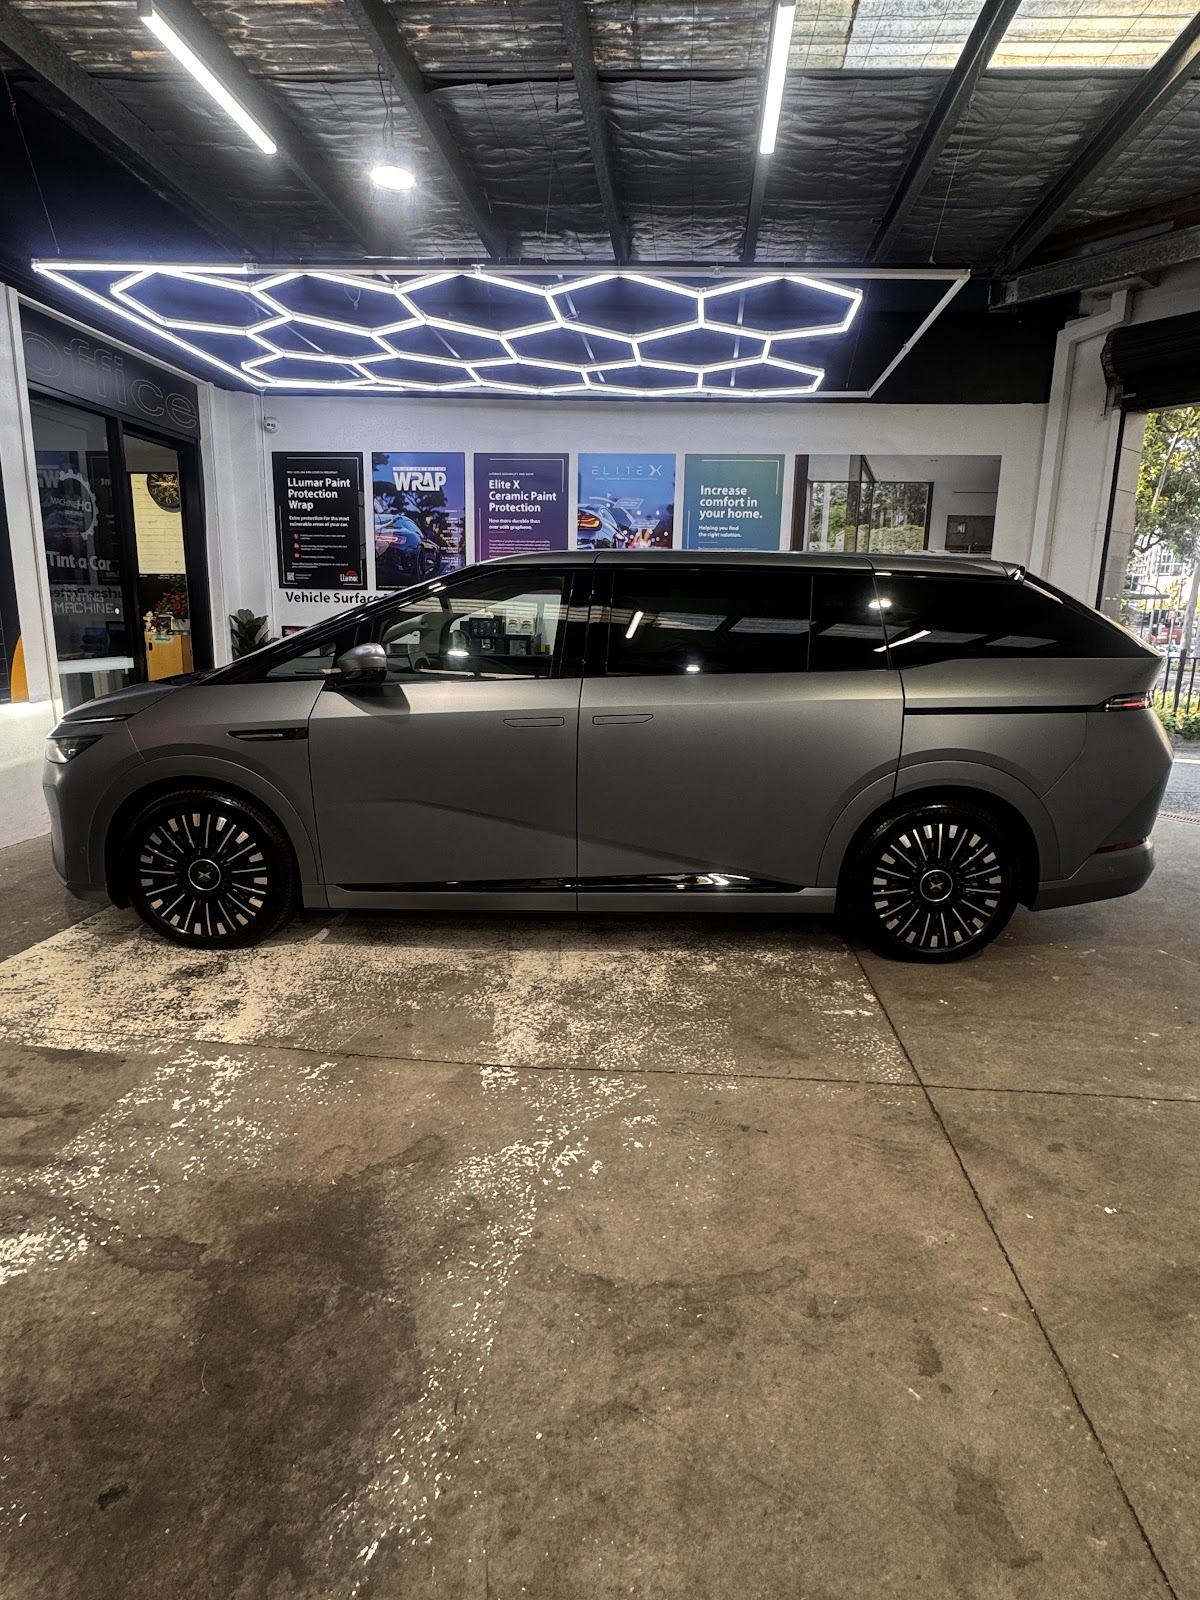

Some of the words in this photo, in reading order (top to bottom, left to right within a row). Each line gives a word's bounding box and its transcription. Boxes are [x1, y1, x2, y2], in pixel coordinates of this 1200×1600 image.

[22, 330, 198, 429] Office
[287, 478, 324, 487] LLumar
[325, 478, 351, 487] Paint
[393, 472, 447, 491] WRAP
[488, 479, 511, 489] Elite
[513, 480, 520, 489] X
[288, 489, 338, 498] Protection
[700, 485, 748, 495] Increase
[488, 491, 529, 501] Ceramic
[531, 491, 557, 501] Paint
[288, 500, 314, 511] Wrap
[700, 496, 745, 507] comfort
[747, 496, 758, 507] in
[488, 502, 541, 512] Protection
[699, 510, 726, 520] your
[727, 508, 763, 518] home.
[285, 591, 331, 603] Vehicle
